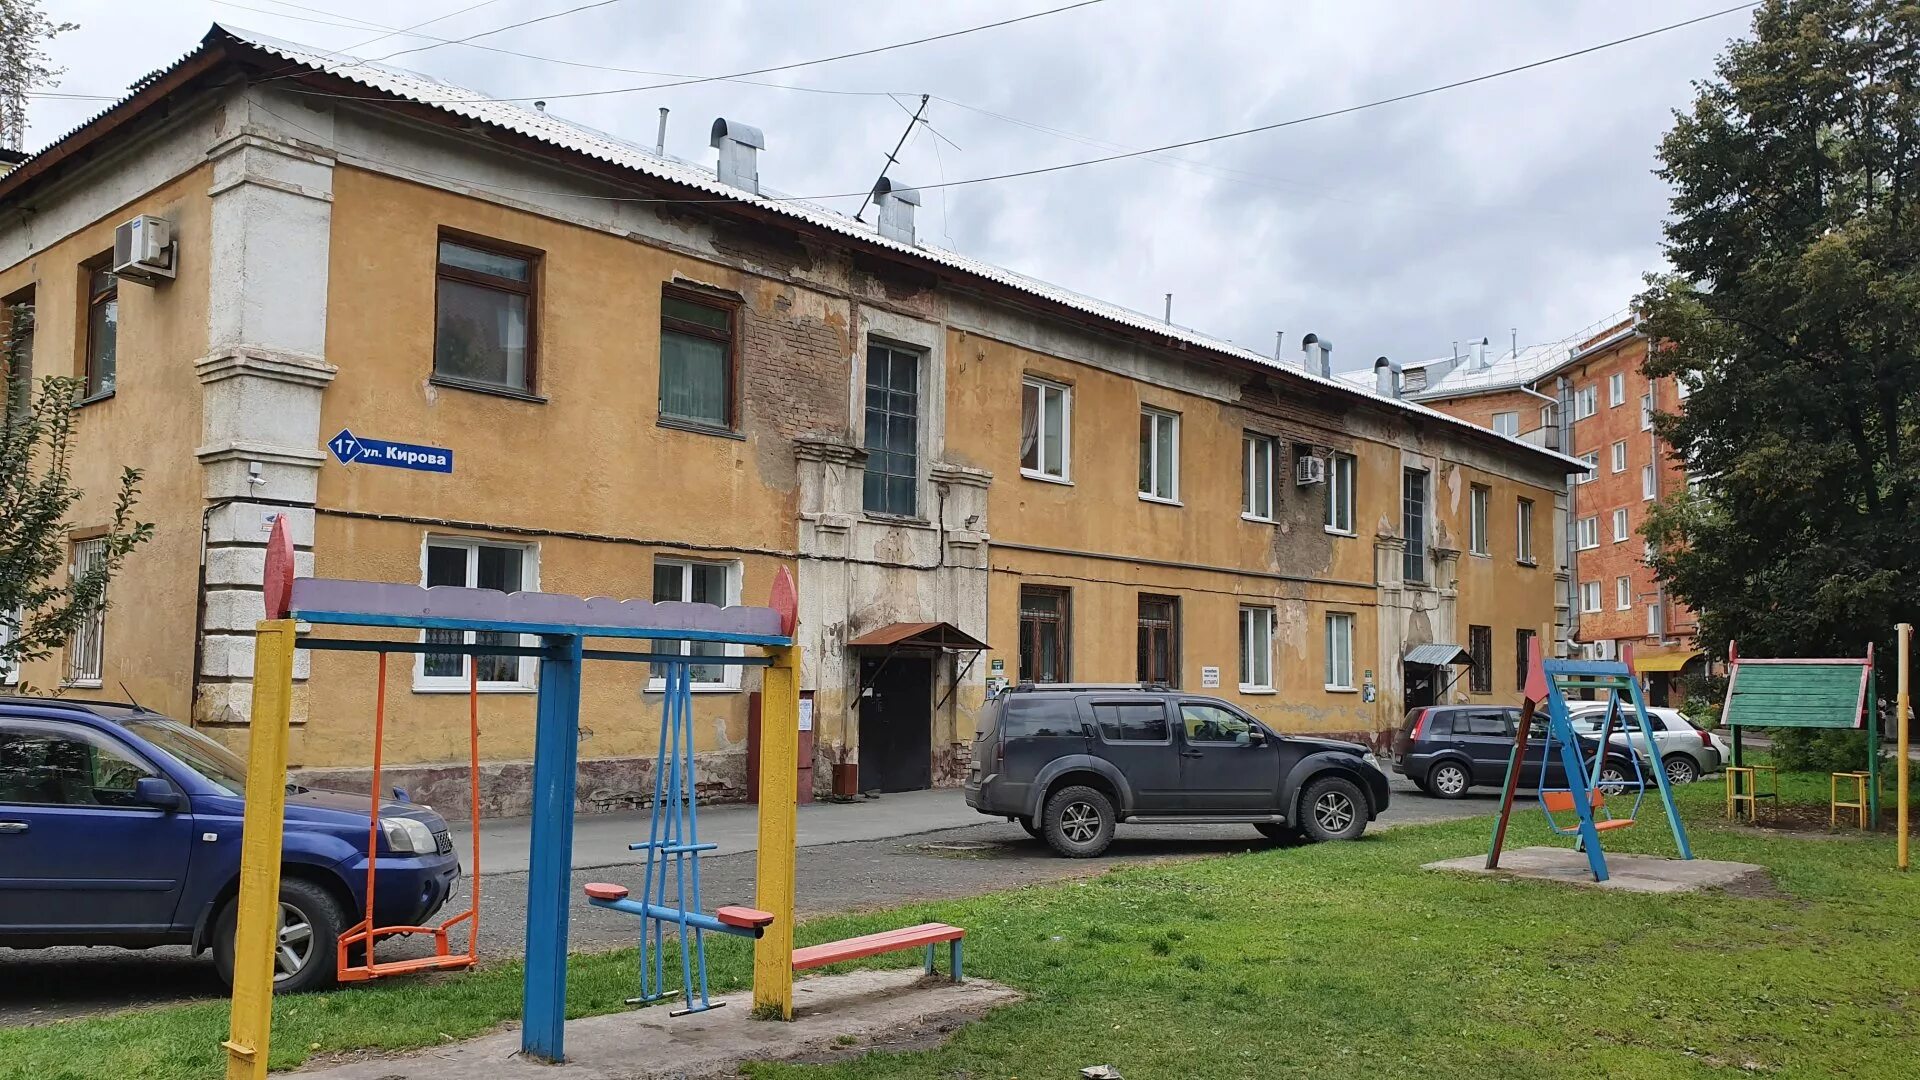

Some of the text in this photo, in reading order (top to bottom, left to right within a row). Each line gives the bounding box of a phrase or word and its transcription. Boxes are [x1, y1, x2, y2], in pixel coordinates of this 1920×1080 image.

[335, 438, 447, 466] 17 ул. Кирова
